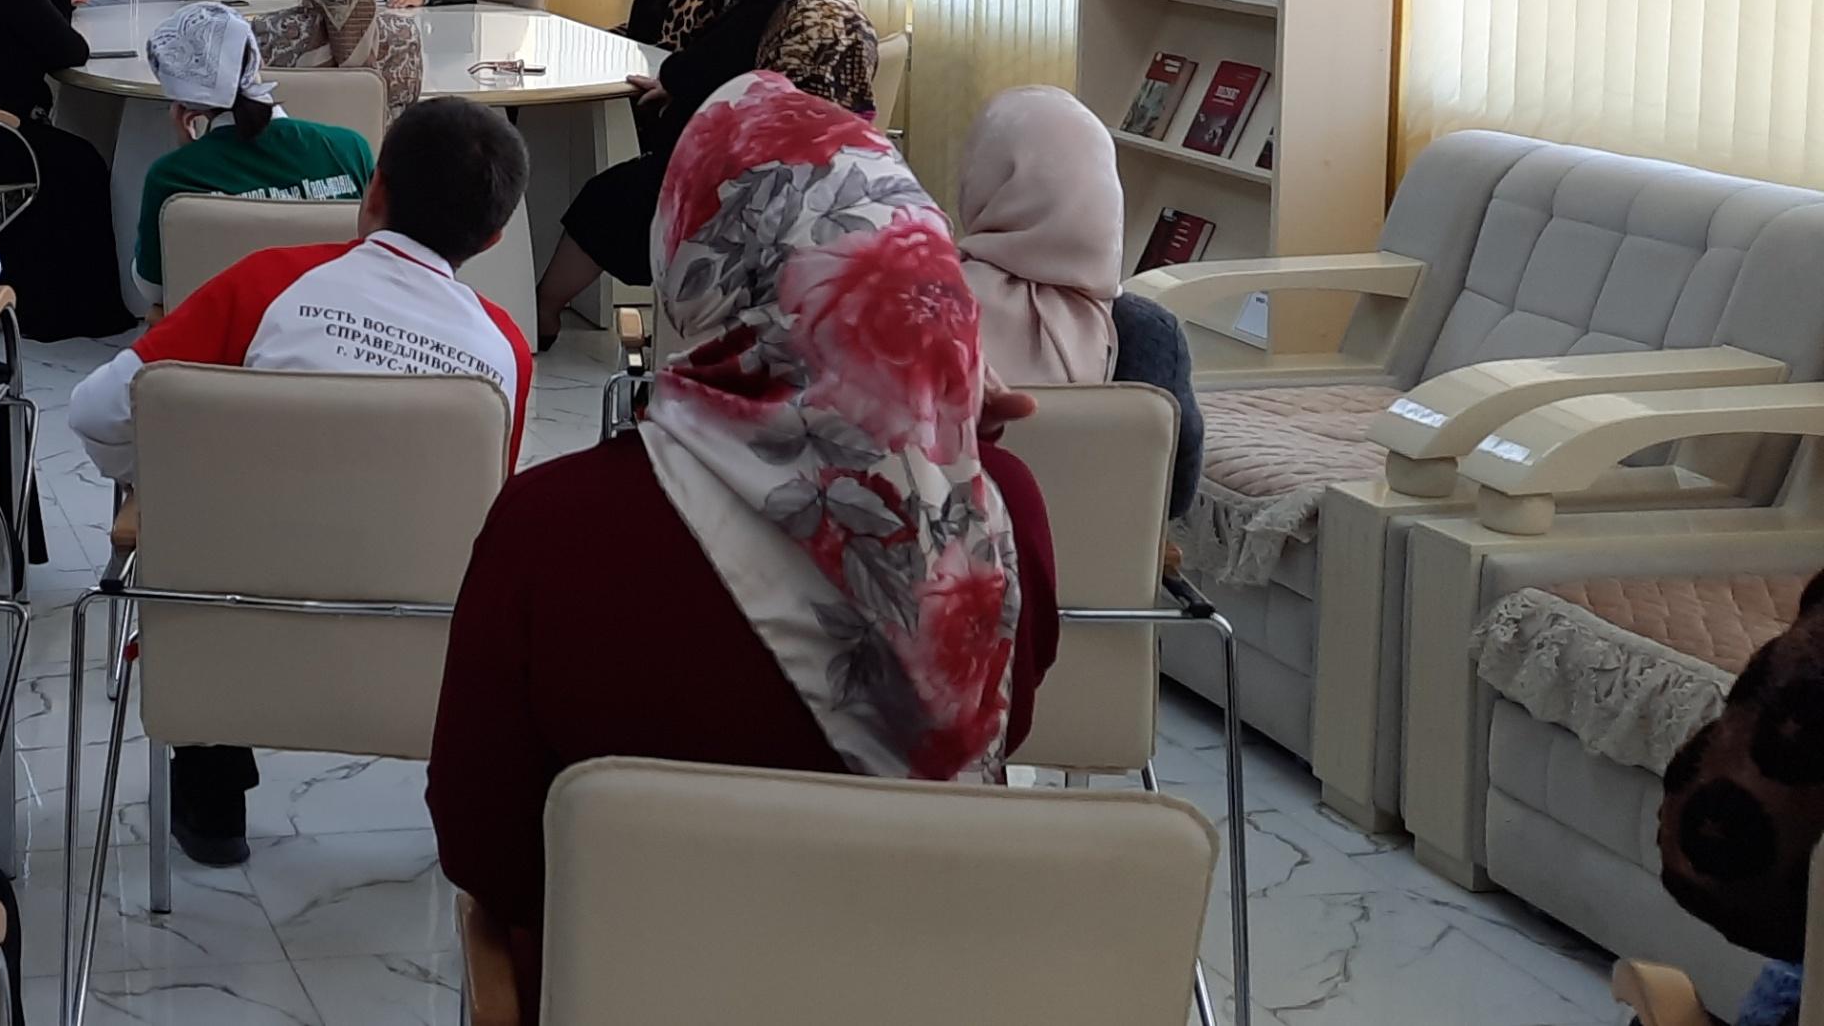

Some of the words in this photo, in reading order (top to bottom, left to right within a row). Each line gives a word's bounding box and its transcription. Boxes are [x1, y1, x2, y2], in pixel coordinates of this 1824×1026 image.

[298, 304, 357, 325] ПУСТЬ
[363, 317, 505, 387] ВОСТОРЖЕСТВУЕТ
[336, 345, 348, 357] г.
